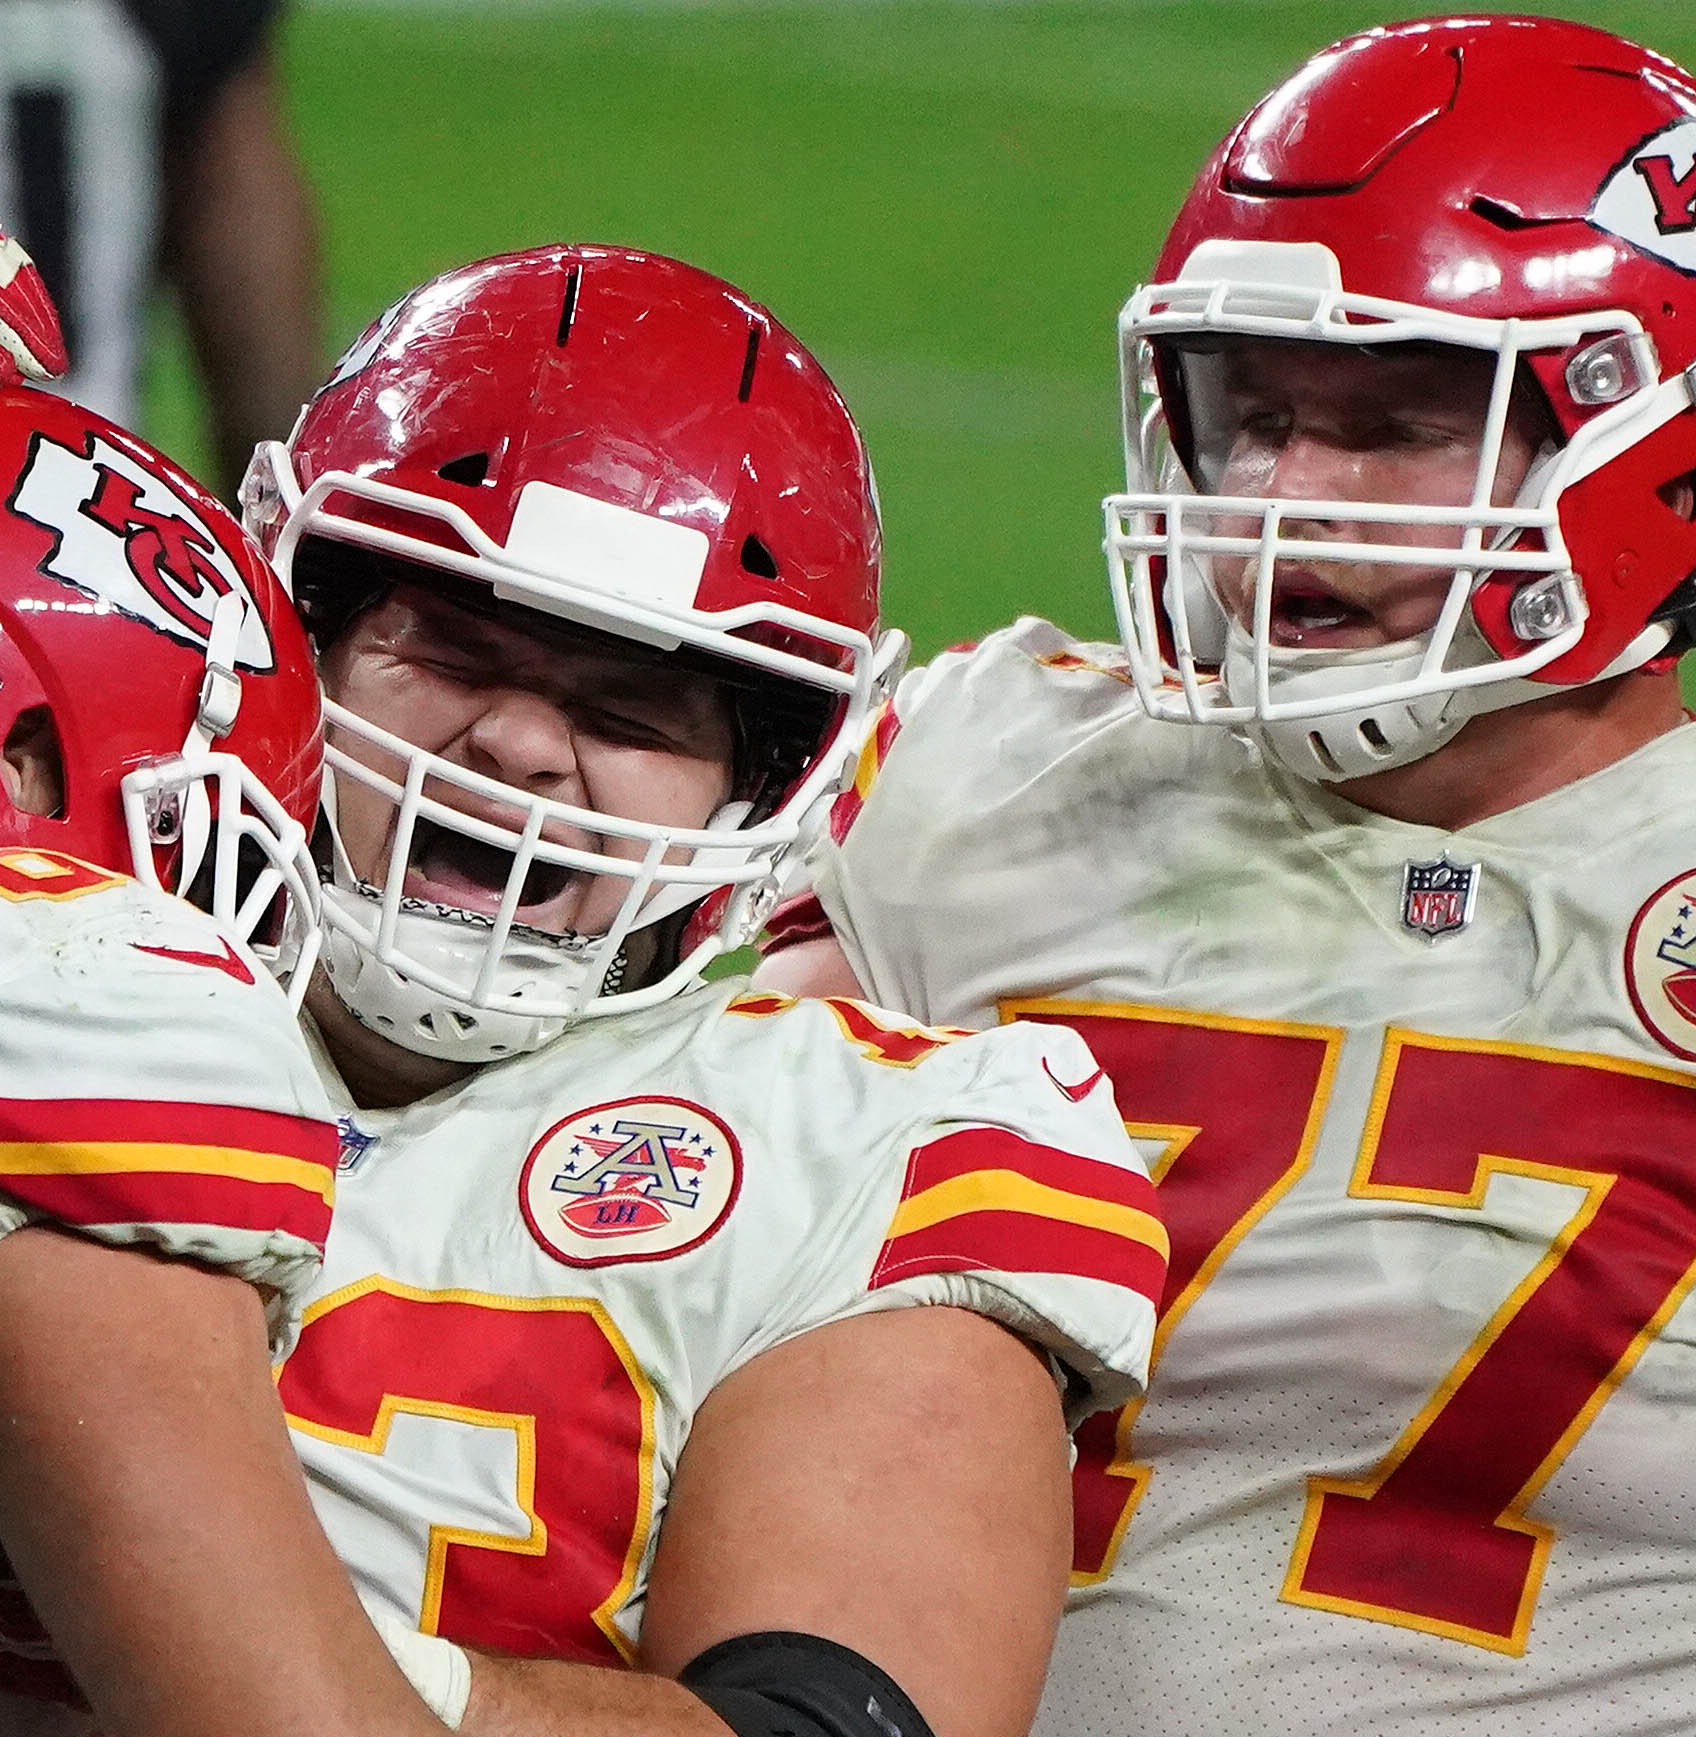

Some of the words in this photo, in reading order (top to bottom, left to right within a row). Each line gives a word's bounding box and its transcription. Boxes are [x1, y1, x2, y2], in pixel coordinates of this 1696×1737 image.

[78, 462, 248, 642] KC
[1410, 893, 1462, 927] NFL
[551, 1120, 699, 1209] A
[593, 1204, 640, 1225] LH
